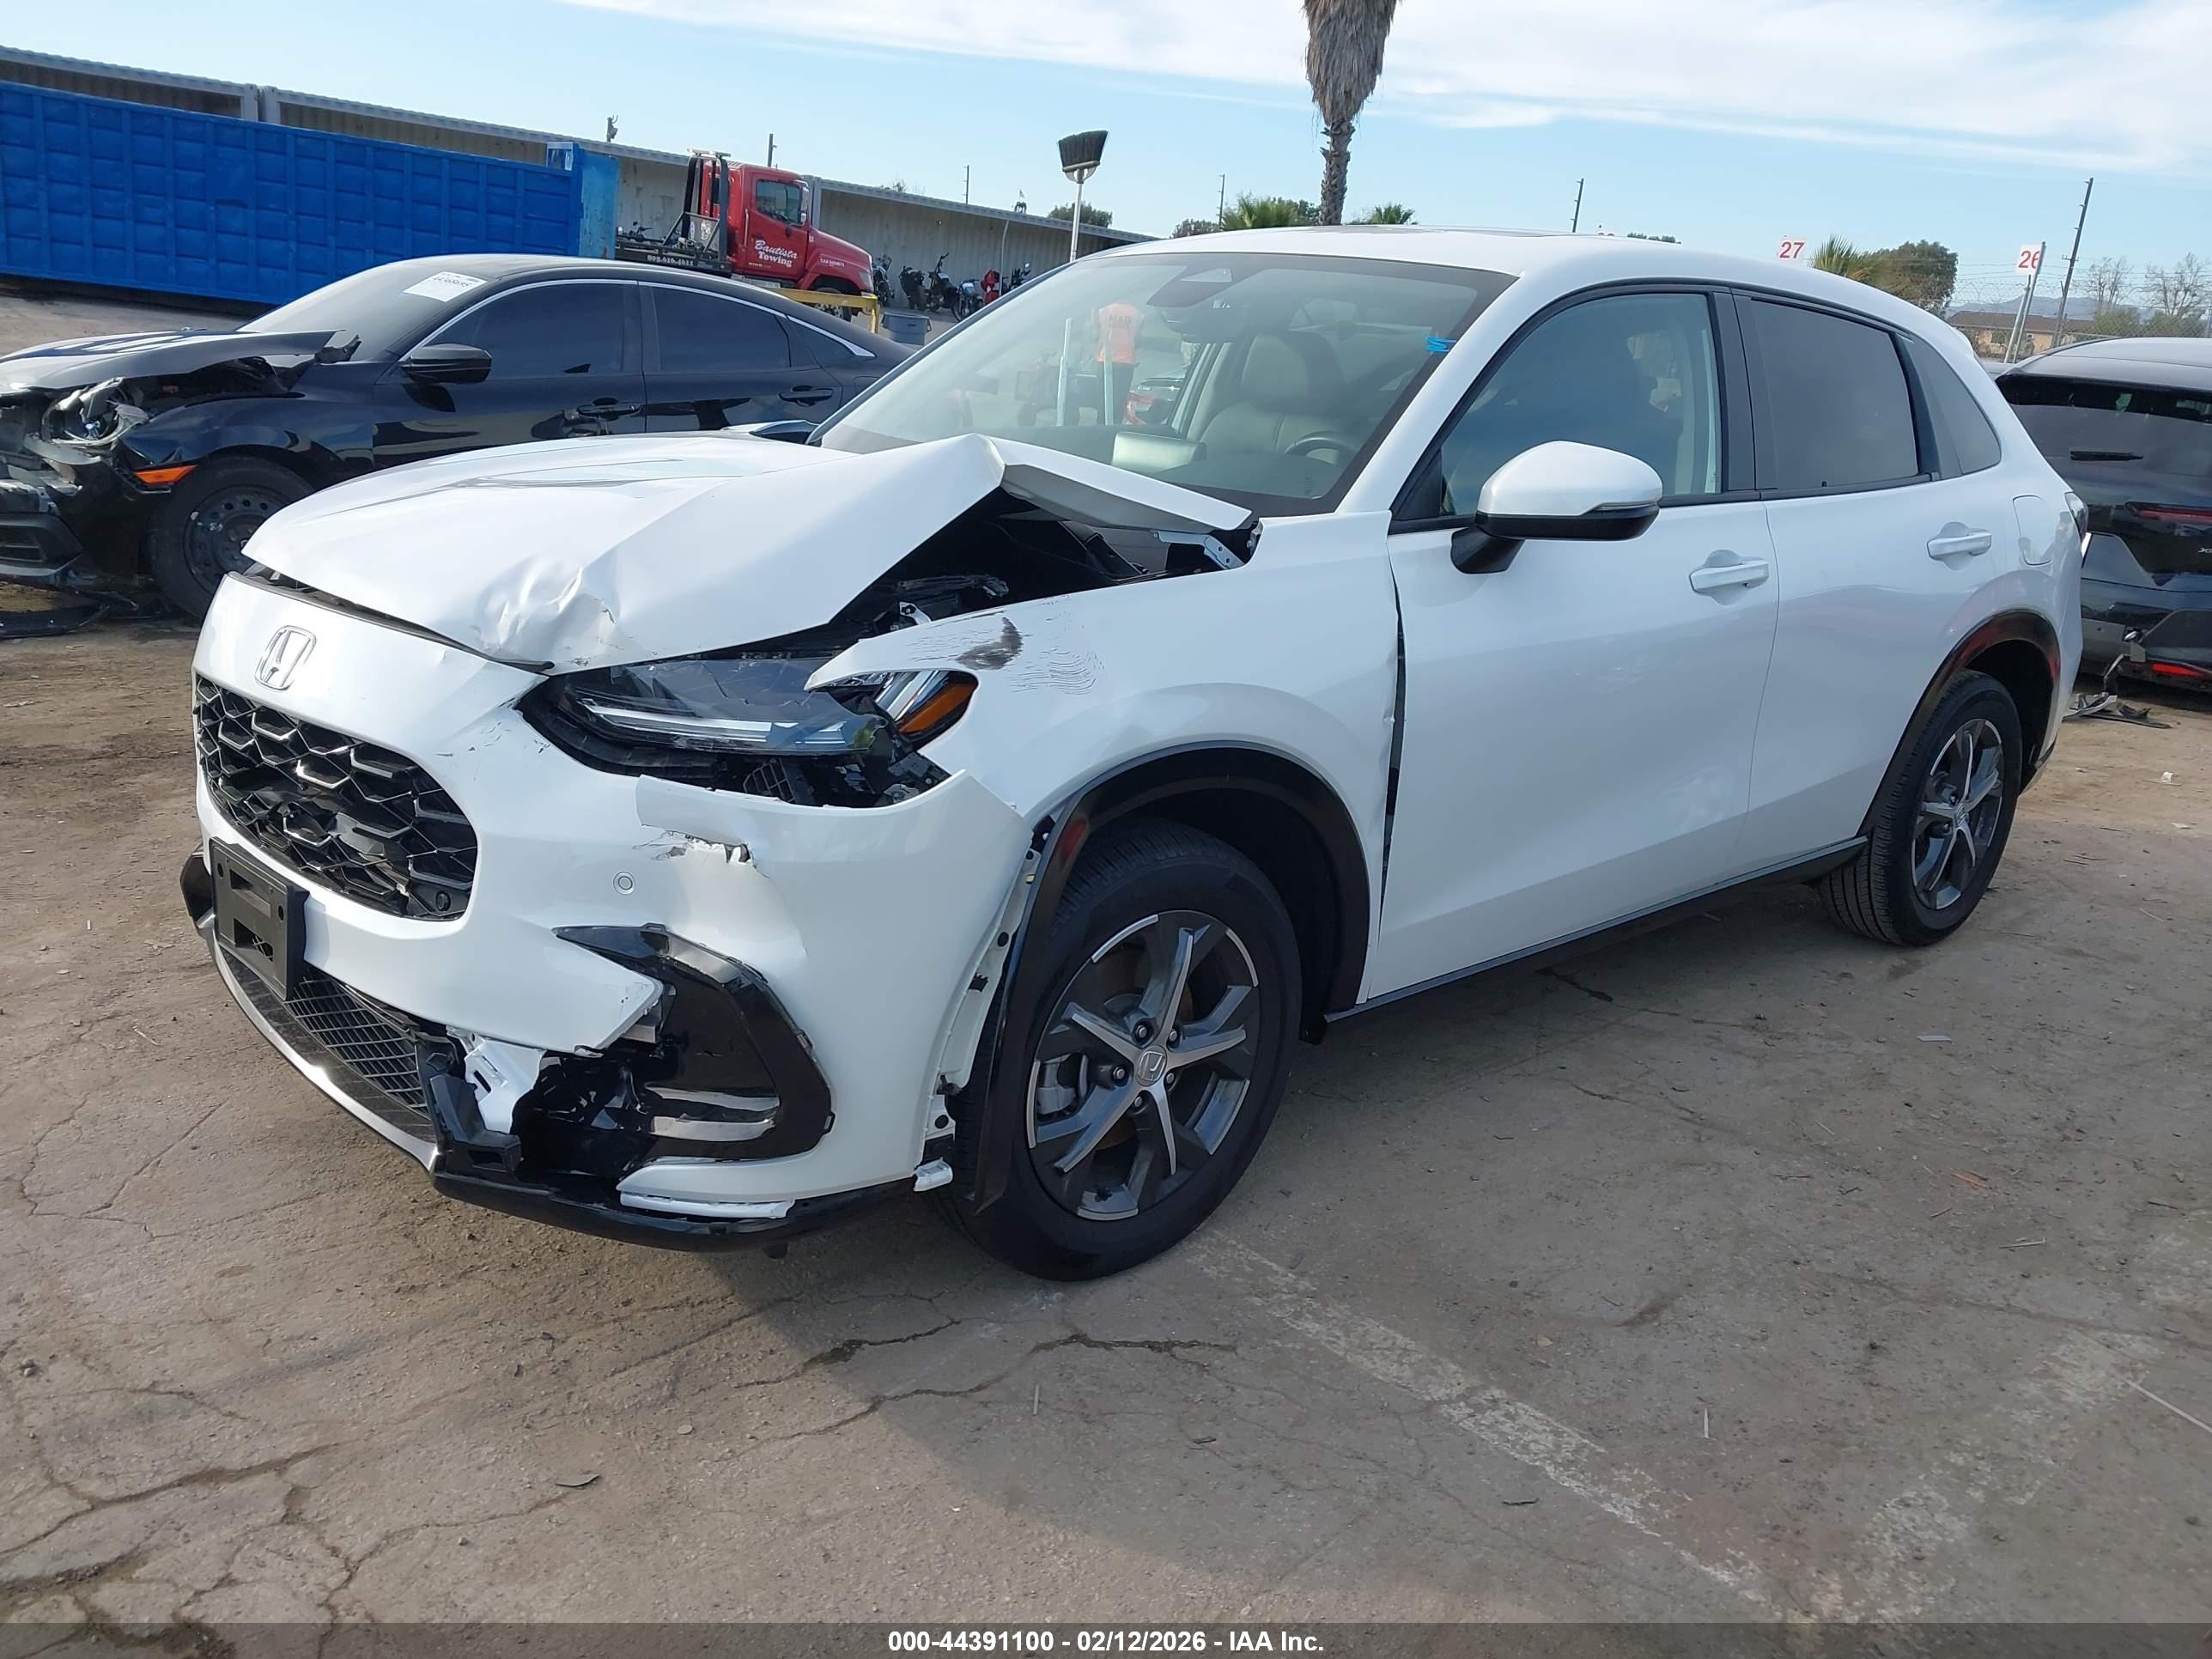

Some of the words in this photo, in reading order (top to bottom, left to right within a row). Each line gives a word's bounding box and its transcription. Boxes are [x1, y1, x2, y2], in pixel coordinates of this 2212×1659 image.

[755, 240, 798, 259] Bautista
[1779, 241, 1805, 259] 27
[757, 251, 793, 268] Towing
[2018, 250, 2040, 269] 26
